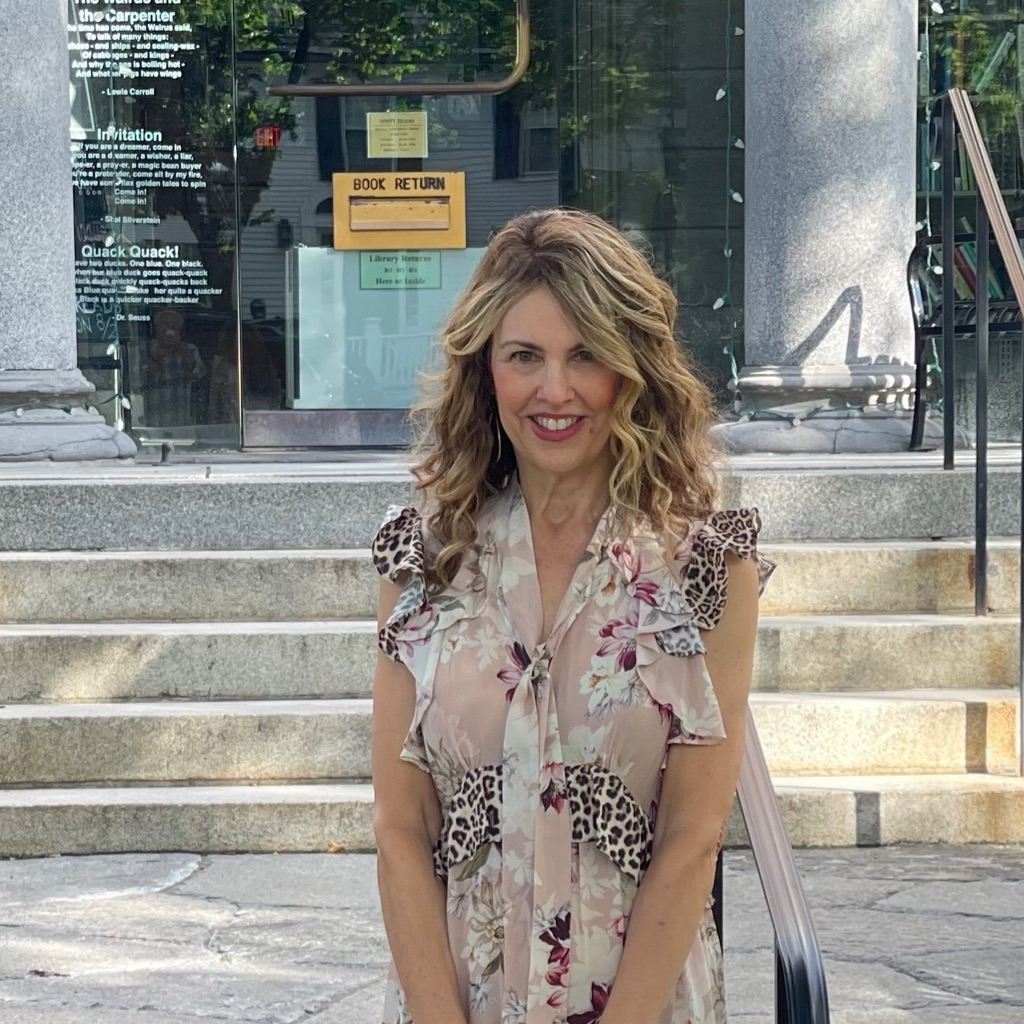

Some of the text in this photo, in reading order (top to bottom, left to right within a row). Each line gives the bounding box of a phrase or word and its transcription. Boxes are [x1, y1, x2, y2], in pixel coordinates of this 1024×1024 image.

[105, 9, 175, 25] Carpenter
[78, 24, 94, 32] time
[95, 24, 109, 32] has
[110, 24, 133, 33] come,
[134, 23, 146, 32] the
[147, 23, 173, 32] Walrus
[174, 23, 192, 33] said,
[86, 33, 169, 43] To talk of many things:
[95, 42, 110, 50] and
[111, 43, 131, 51] ships
[136, 42, 150, 50] and
[152, 42, 195, 51] sealing-wax
[82, 51, 92, 60] Of
[134, 51, 148, 59] and
[149, 51, 170, 60] kings
[71, 61, 88, 69] And
[88, 61, 104, 70] why
[133, 61, 140, 69] is
[141, 61, 167, 70] boiling
[168, 61, 181, 69] hot
[75, 70, 92, 78] And
[140, 70, 159, 78] have
[160, 70, 182, 79] wings
[106, 88, 155, 96] Lewis Carroll
[85, 143, 98, 152] you
[119, 142, 151, 152] dreamer,
[174, 143, 182, 151] in
[107, 151, 139, 160] deamer,
[147, 152, 172, 161] wisher,
[180, 152, 194, 161] liar,
[138, 161, 160, 171] magic
[161, 162, 179, 170] bean
[180, 162, 202, 172] buyer
[154, 170, 164, 178] sit
[164, 170, 174, 180] by
[175, 172, 187, 180] my
[188, 170, 203, 180] fire,
[80, 179, 98, 187] have
[135, 180, 161, 190] golden
[162, 179, 180, 188] tales
[181, 180, 189, 188] to
[189, 180, 206, 191] spin
[353, 177, 446, 191] BOOK RETURN
[114, 188, 147, 196] Come in!
[114, 197, 147, 205] Come in!
[122, 216, 161, 224] Silverstein
[81, 245, 179, 258] Quack Quack!
[104, 260, 128, 268] ducks.
[129, 259, 145, 268] One
[145, 259, 164, 268] blue.
[165, 259, 180, 268] One
[181, 260, 204, 268] black.
[369, 255, 399, 264] Library
[123, 269, 141, 277] duck
[143, 270, 161, 278] goes
[162, 269, 208, 278] quack-quack
[138, 278, 188, 287] quack-quacks
[190, 278, 208, 286] back
[154, 286, 167, 295] her
[167, 286, 187, 296] quite
[193, 287, 223, 297] quacker
[143, 295, 199, 305] quacker-backer
[116, 314, 151, 322] Dr. Seuss
